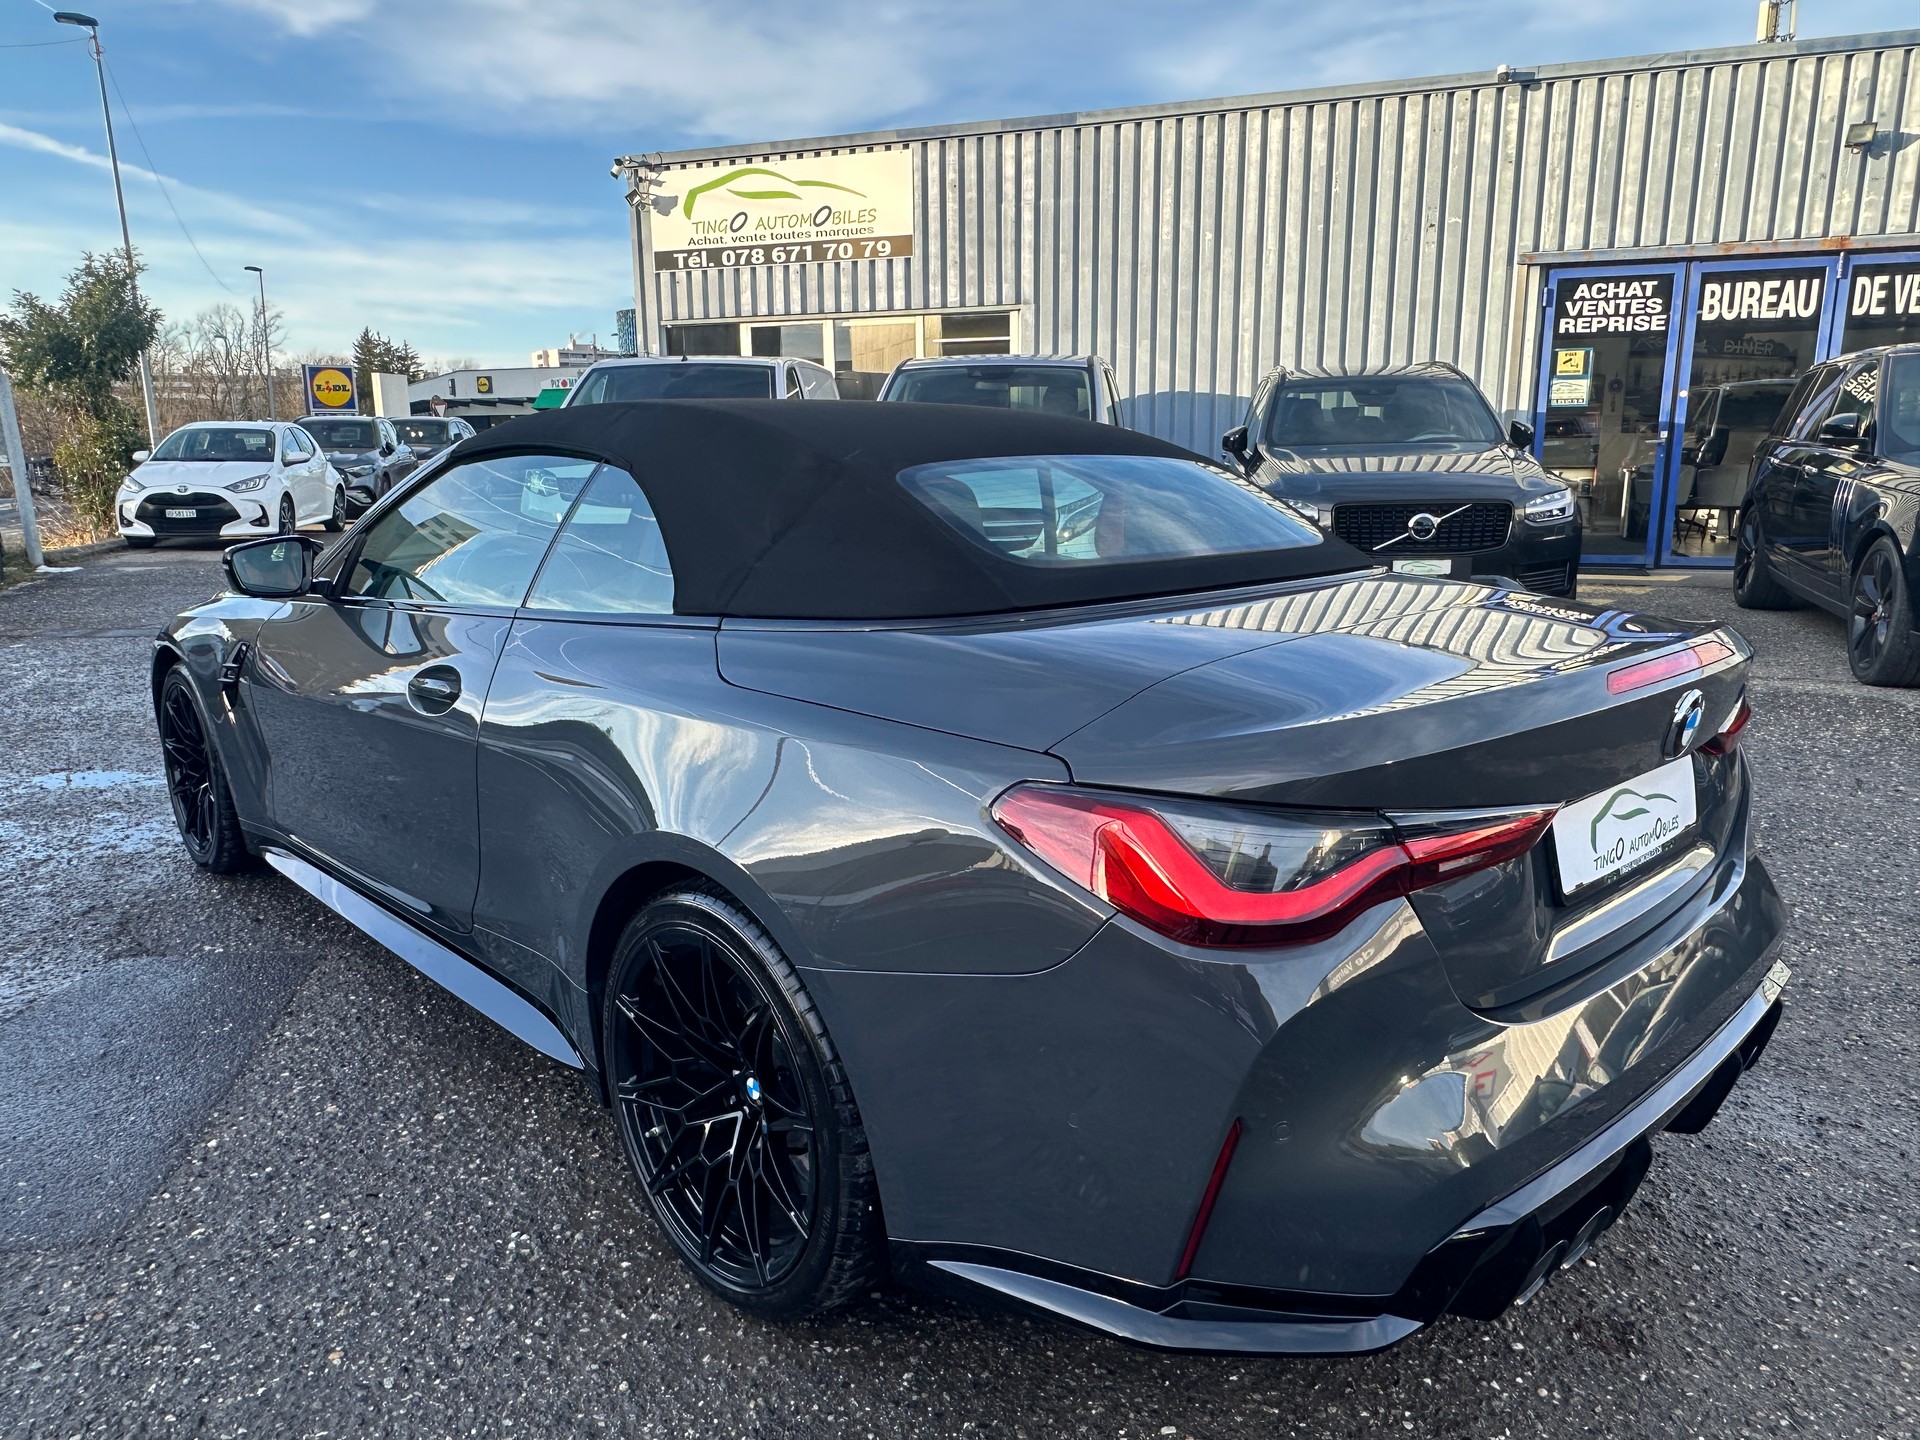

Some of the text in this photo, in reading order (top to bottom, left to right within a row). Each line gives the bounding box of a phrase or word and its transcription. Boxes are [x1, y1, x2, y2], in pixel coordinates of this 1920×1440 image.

[692, 205, 877, 235] TINGO AUTOMOBILES
[731, 233, 767, 243] vente
[770, 230, 812, 241] toutes
[816, 226, 875, 238] marques
[673, 240, 891, 269] Tél. 078 671 70 79
[1573, 281, 1658, 299] ACHAT
[1701, 278, 1820, 321] BUREAU
[1852, 275, 1890, 316] DE
[1565, 298, 1663, 316] VENTES
[1559, 315, 1667, 333] REPRISE
[1593, 837, 1625, 871] TINGO
[1629, 815, 1679, 854] AUTOMOBILES
